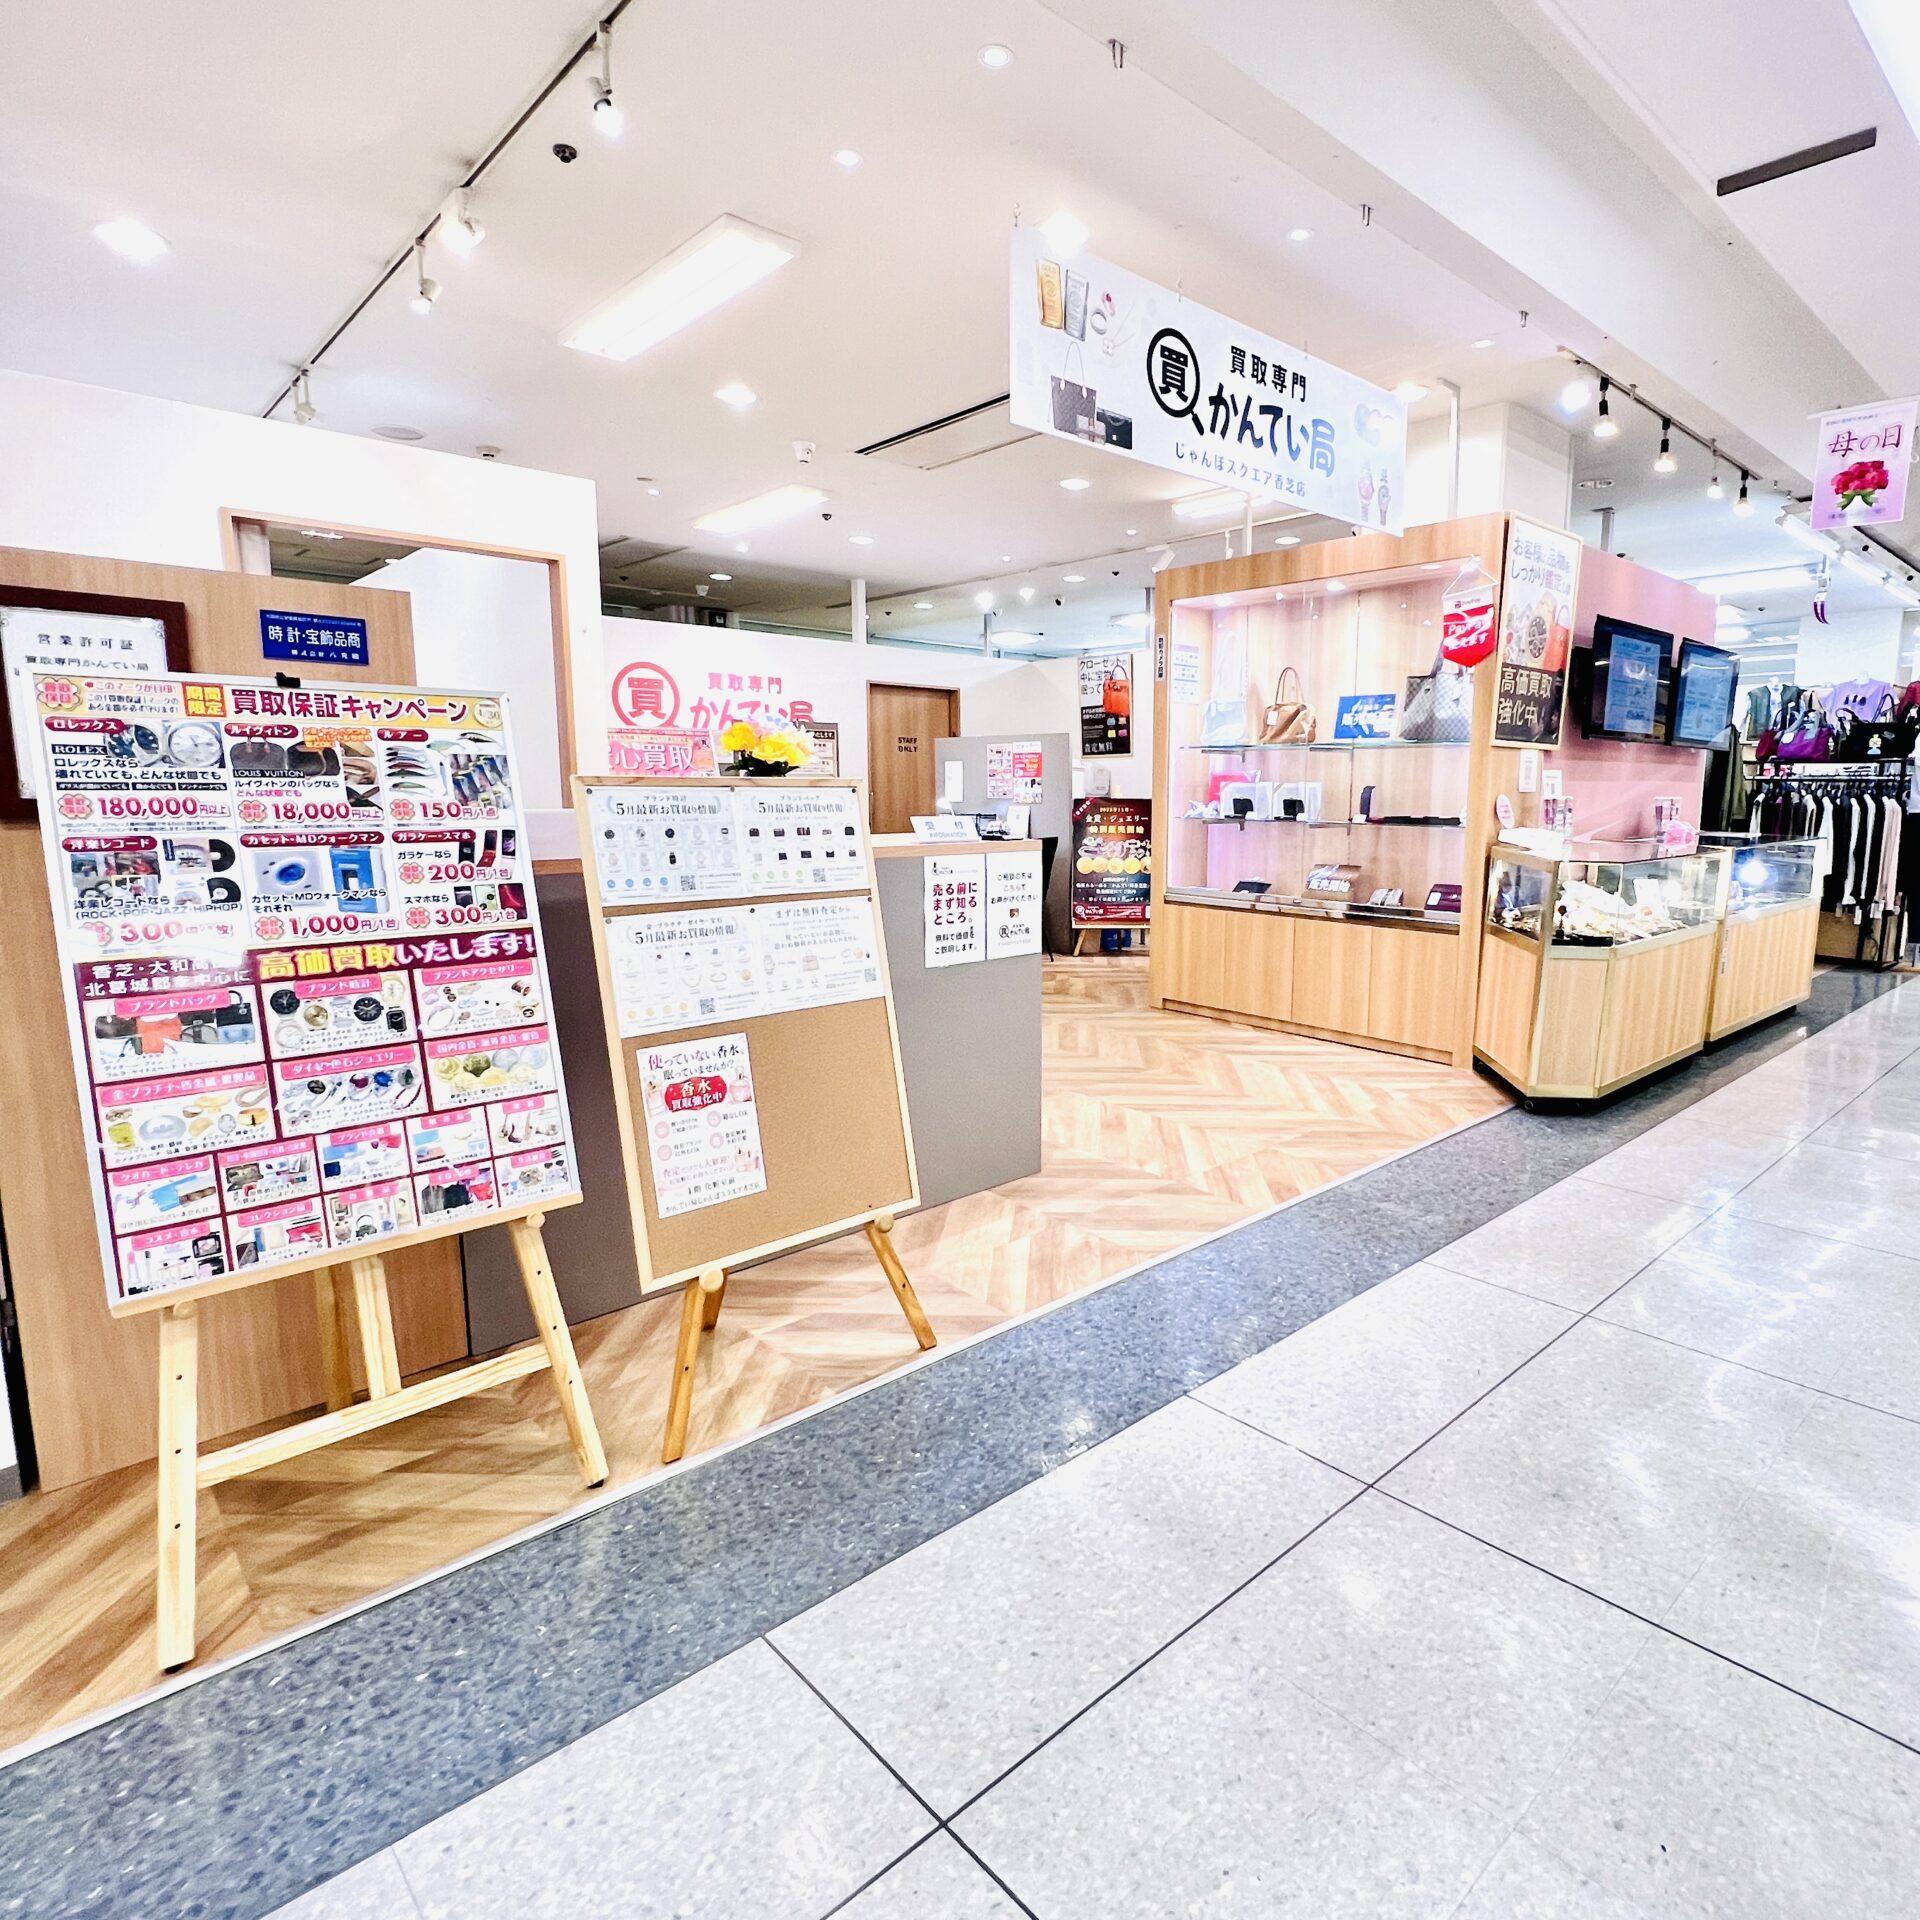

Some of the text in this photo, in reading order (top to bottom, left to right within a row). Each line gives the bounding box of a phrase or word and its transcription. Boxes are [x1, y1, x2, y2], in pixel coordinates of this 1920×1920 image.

[1159, 344, 1189, 403] 買
[1230, 345, 1308, 402] 買取専門
[1208, 382, 1336, 478] かんてい局
[1828, 424, 1903, 457] 母の日
[37, 633, 133, 651] 営業許可証
[268, 625, 361, 649] 時計・宝飾品商
[707, 672, 783, 695] 買取専門
[1500, 666, 1553, 699] 高価買取
[231, 688, 468, 722] 買取保証キャンペーン
[1498, 697, 1538, 728] 強化中
[53, 718, 118, 731] ロレックス
[231, 725, 293, 736] ルイヴィトン
[383, 730, 423, 739] ルアー
[898, 736, 918, 745] STAFF
[55, 745, 107, 755] ROLEX
[898, 745, 918, 753] ONLY
[54, 758, 139, 769] ロレックスなら
[608, 745, 695, 772] 心買取
[234, 769, 304, 779] LOUIS VUITTON
[70, 837, 151, 850] 洋楽レコード
[933, 881, 978, 897] 売る前に
[933, 896, 977, 911] まず知る
[257, 932, 535, 980] 高価買取いたします!
[680, 1079, 712, 1098] 香水
